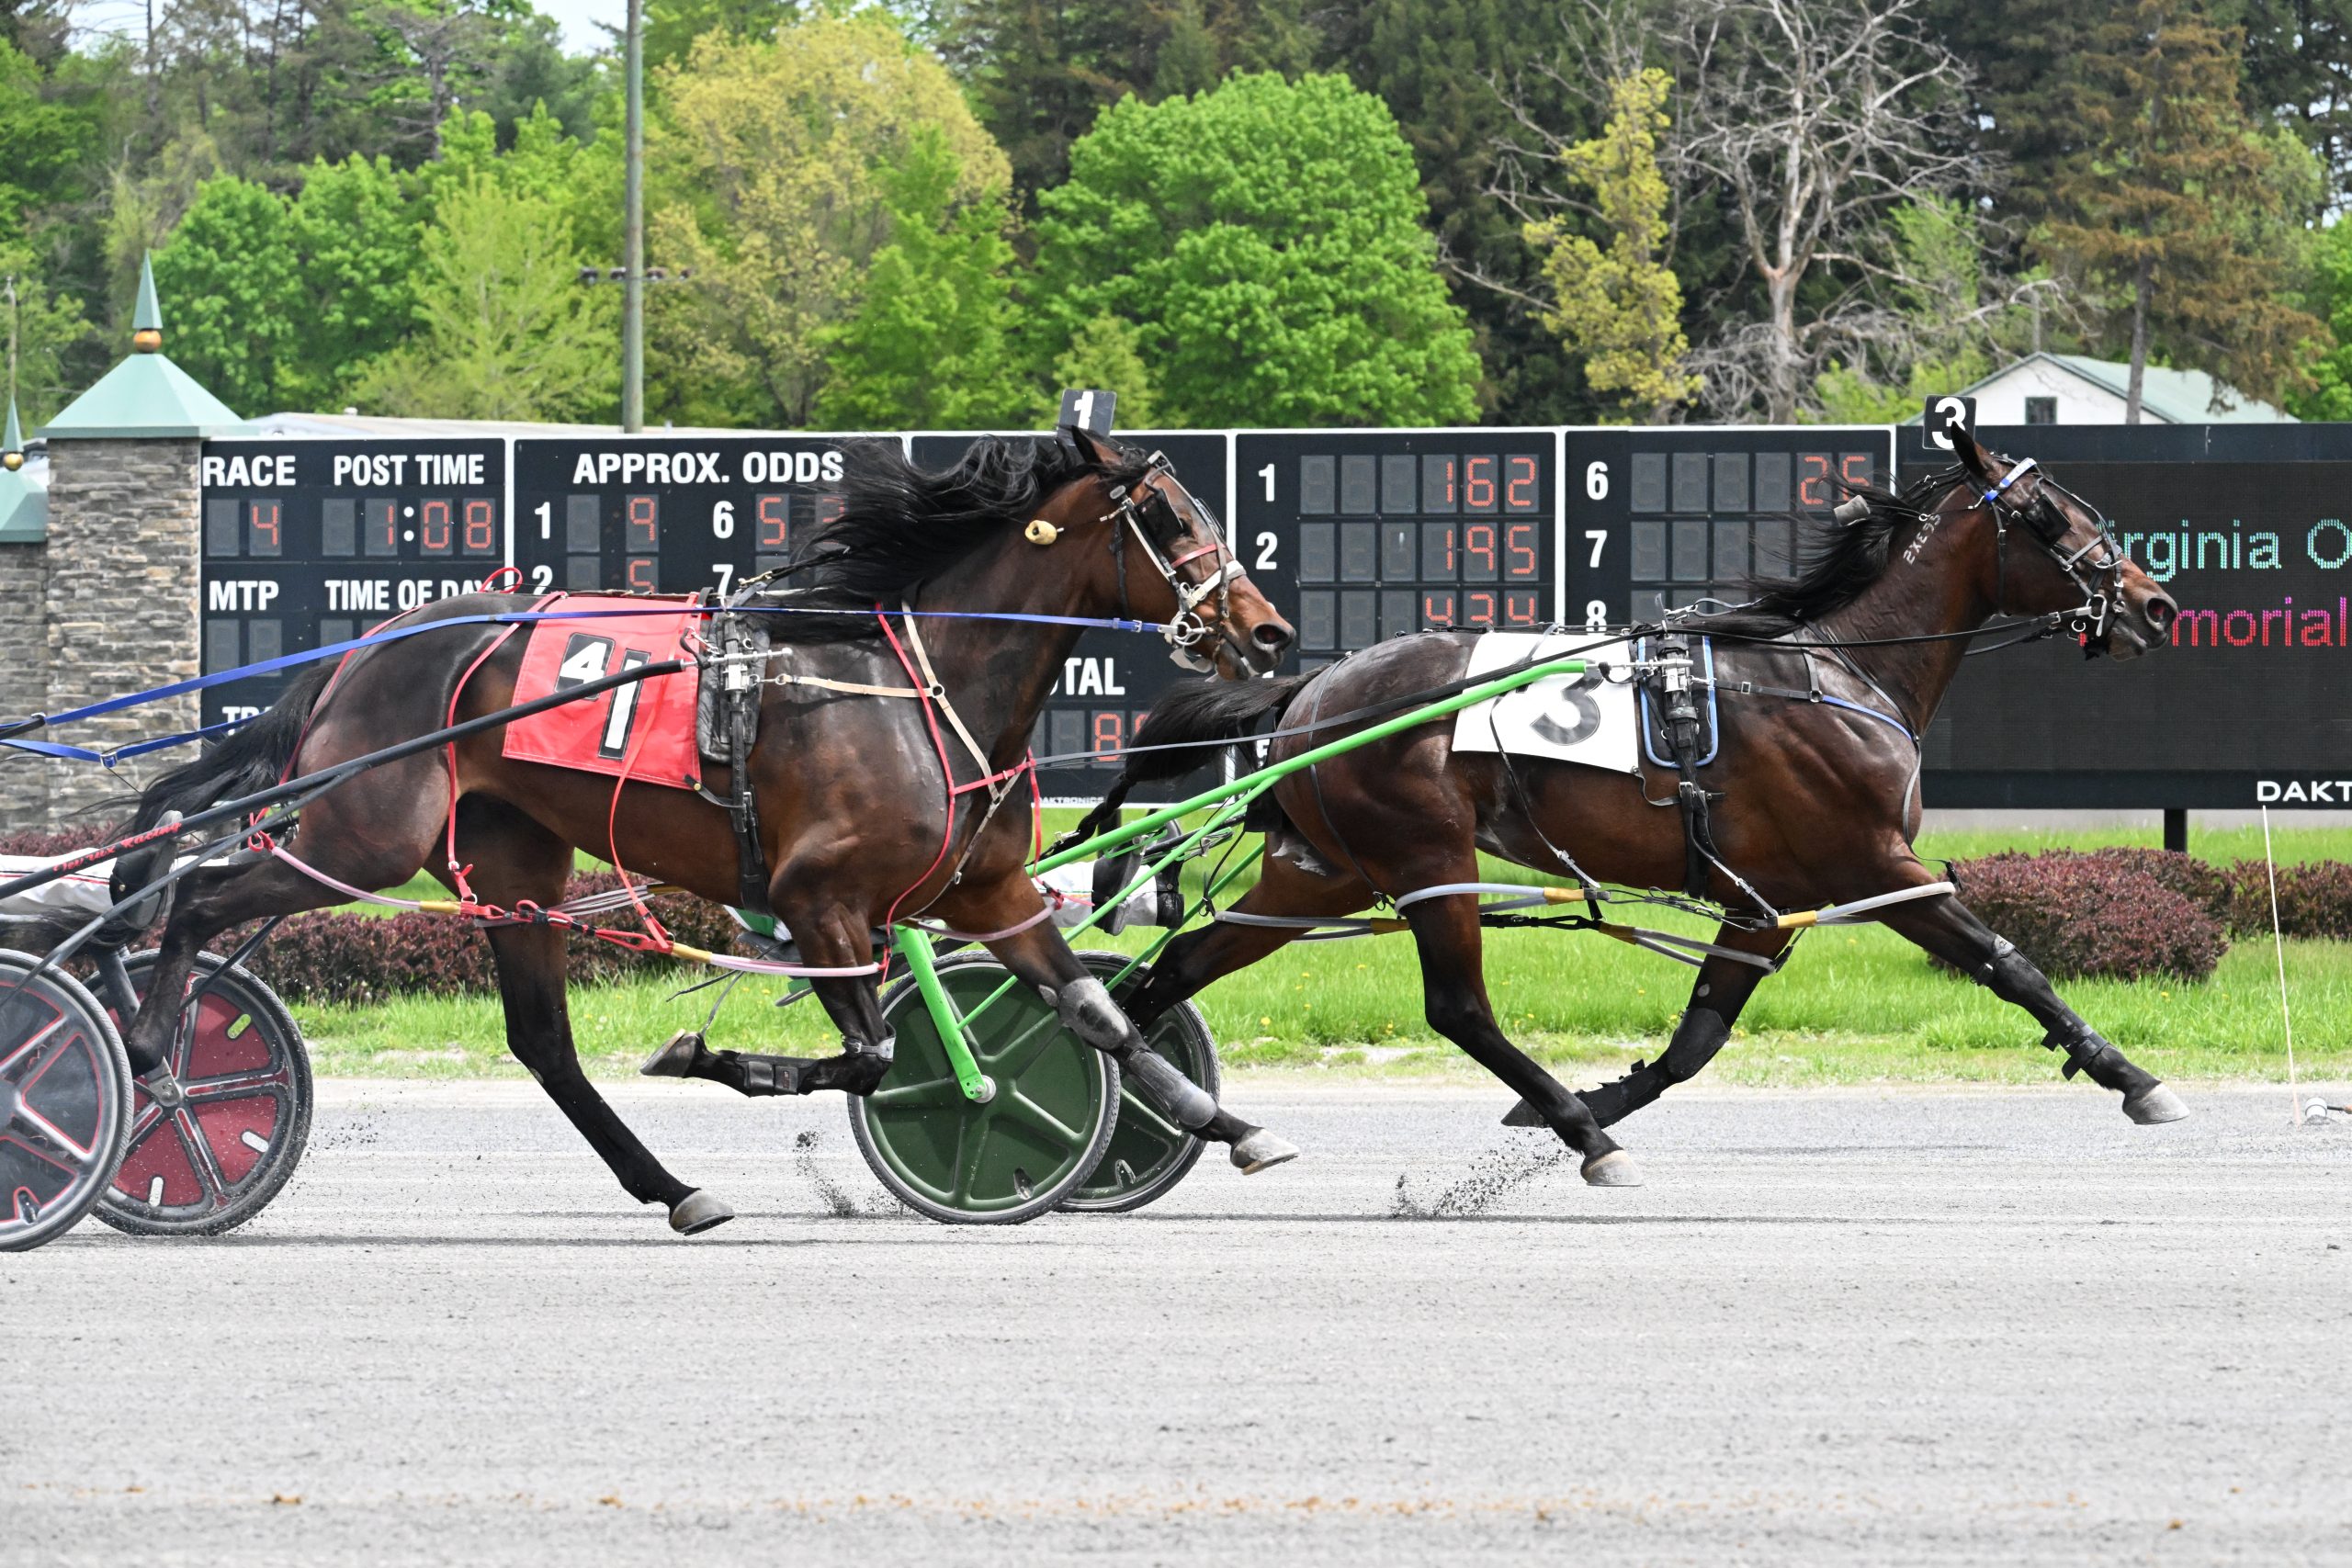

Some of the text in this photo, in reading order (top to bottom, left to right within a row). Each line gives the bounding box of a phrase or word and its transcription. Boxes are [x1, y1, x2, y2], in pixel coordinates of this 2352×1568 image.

[1074, 391, 1093, 429] 1
[1932, 397, 1966, 449] 3
[202, 456, 296, 486] RACE
[334, 454, 484, 486] POST TIME
[572, 452, 844, 484] APPROX. ODDS
[1258, 463, 1275, 502] 1
[1444, 457, 1536, 507] 162
[1586, 461, 1609, 501] 6
[252, 505, 277, 546] 4
[534, 502, 550, 539] 1
[628, 497, 655, 543] 9
[713, 501, 735, 539] 6
[1256, 532, 1278, 570] 2
[1444, 525, 1536, 575] 195
[1585, 530, 1608, 568] 7
[2096, 519, 2282, 582] rginia
[209, 581, 279, 611] MTP
[325, 581, 390, 611] TIME
[398, 581, 433, 610] OF
[532, 565, 552, 595] 2
[712, 564, 734, 603] 7
[1586, 600, 1607, 632] 8
[2170, 596, 2347, 647] morial
[1049, 657, 1125, 695] TAL
[2256, 781, 2352, 802] DAKT
